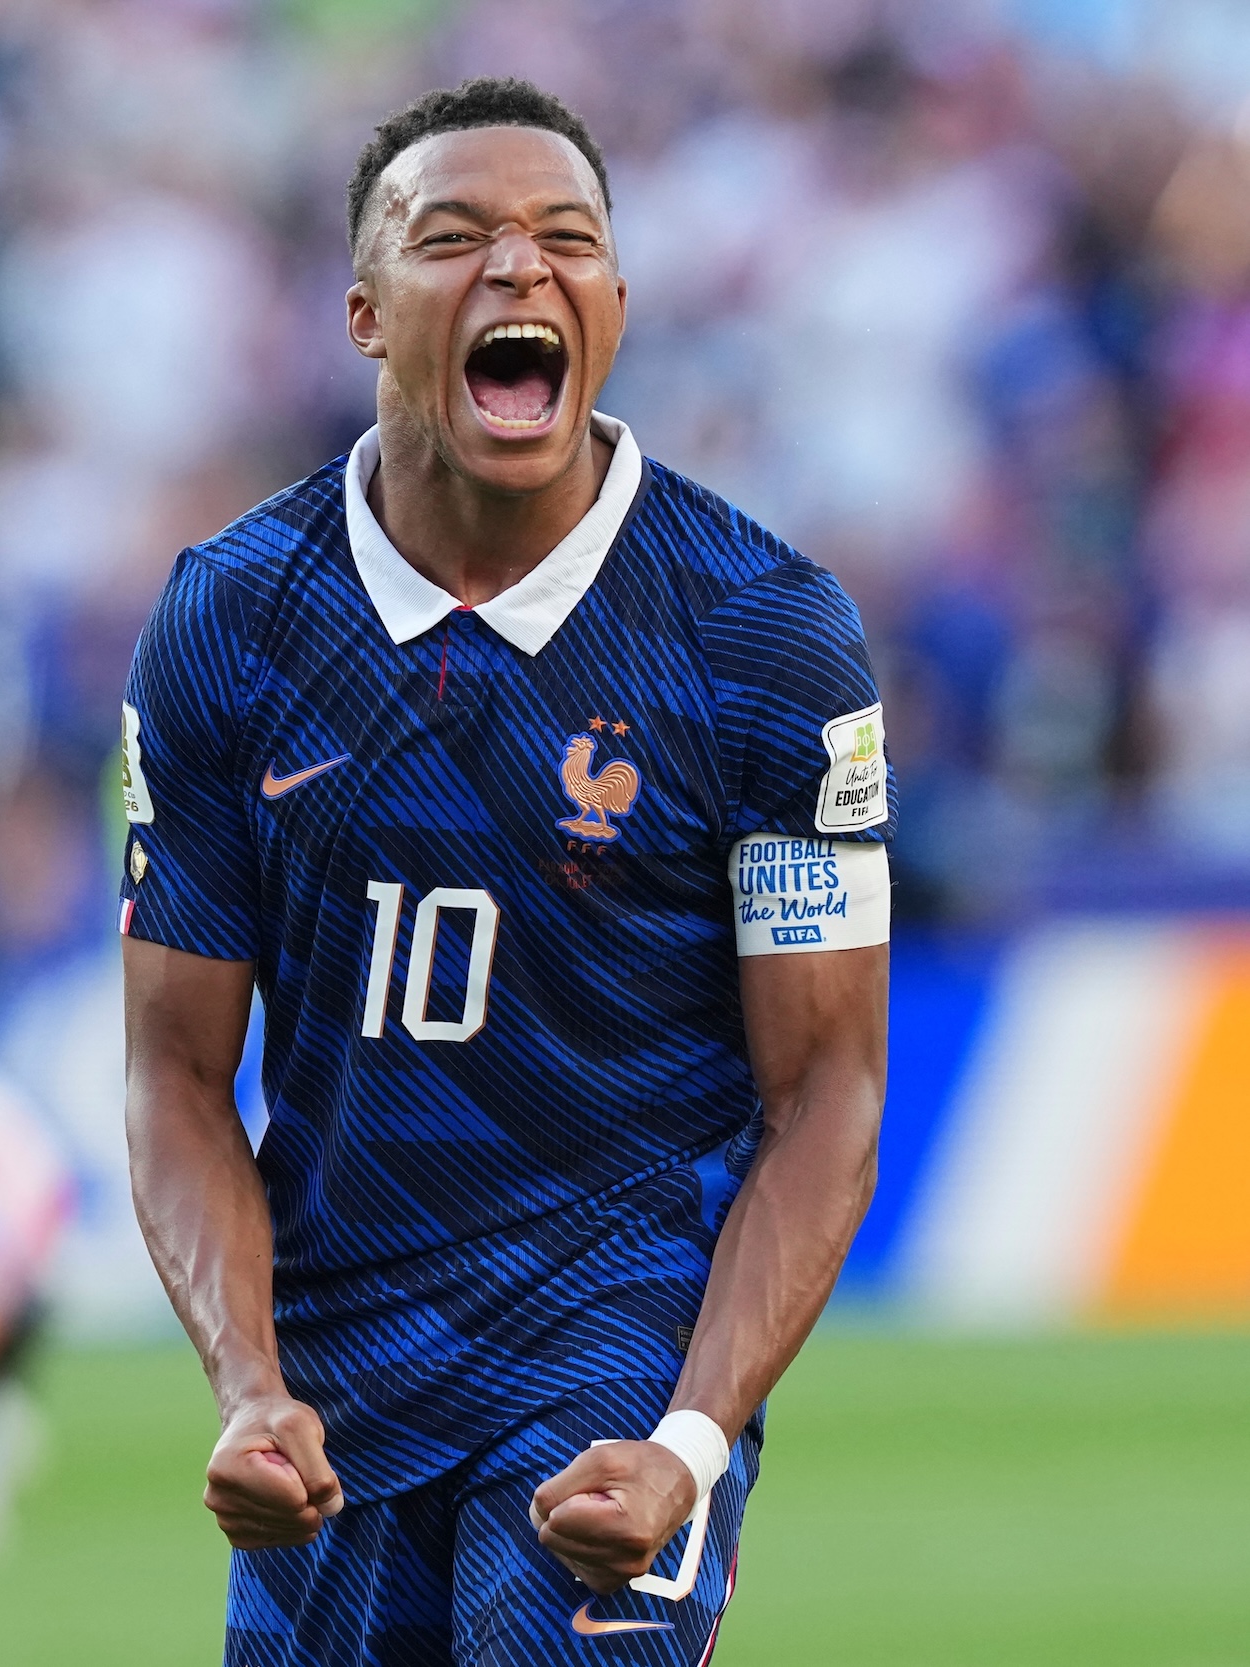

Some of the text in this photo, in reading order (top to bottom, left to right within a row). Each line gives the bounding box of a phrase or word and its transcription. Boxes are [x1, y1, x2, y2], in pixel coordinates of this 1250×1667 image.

[845, 766, 870, 787] Unite
[835, 780, 880, 807] EDUCATION
[852, 806, 869, 817] FIFA
[739, 839, 836, 864] FOOTBALL
[738, 860, 839, 895] UNITES
[738, 891, 848, 925] the World
[776, 928, 819, 942] FIFA
[361, 879, 501, 1043] 10
